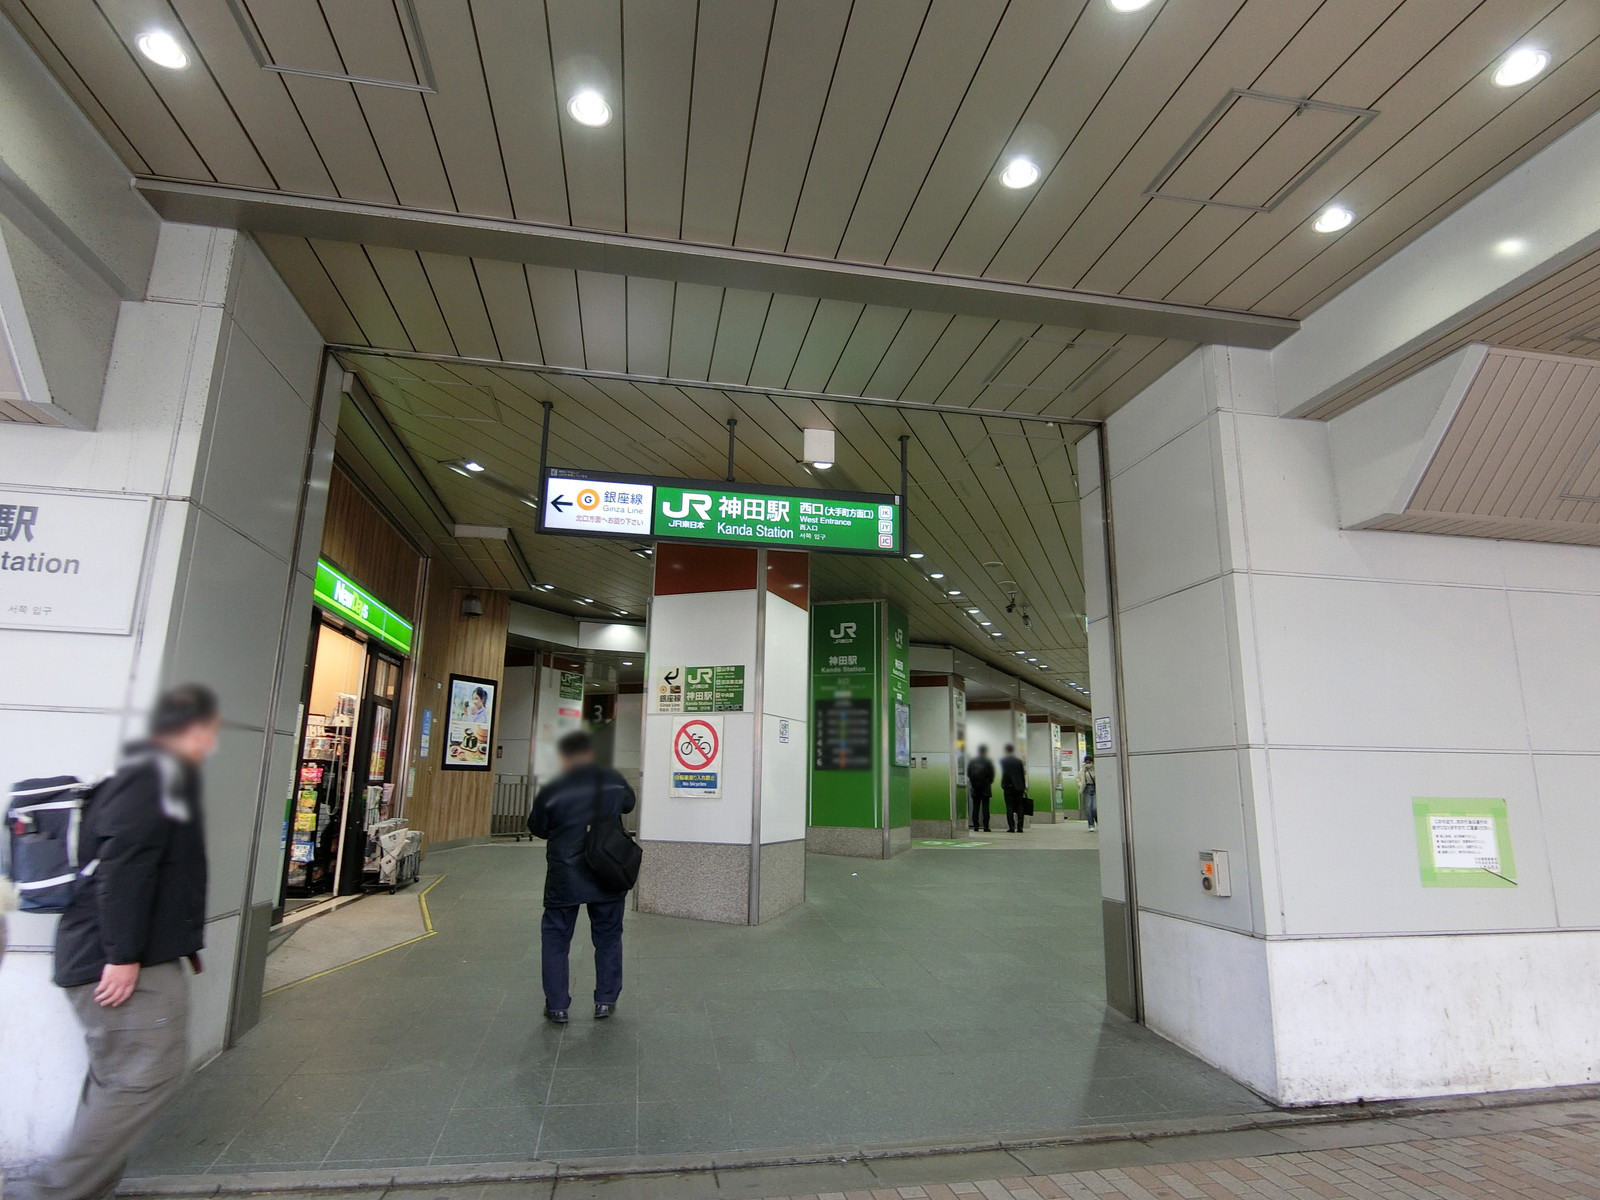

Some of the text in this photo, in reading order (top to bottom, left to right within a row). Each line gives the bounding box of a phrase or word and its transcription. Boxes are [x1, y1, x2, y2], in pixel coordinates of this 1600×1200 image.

[604, 491, 643, 506] 銀座線
[602, 505, 644, 515] Ginza Line
[662, 492, 712, 520] JR
[718, 496, 790, 523] 神田駅
[576, 514, 644, 526] 北口方面へお回り下さい
[668, 519, 705, 529] JR東日本
[799, 516, 852, 527] West Entrance
[717, 522, 793, 539] Kanda Station
[881, 537, 890, 545] JC
[829, 622, 857, 639] JR
[828, 655, 858, 666] 神田駅
[687, 668, 713, 684] JR
[659, 694, 681, 702] 銀座線
[686, 691, 713, 701] 神田駅
[594, 704, 603, 723] 3
